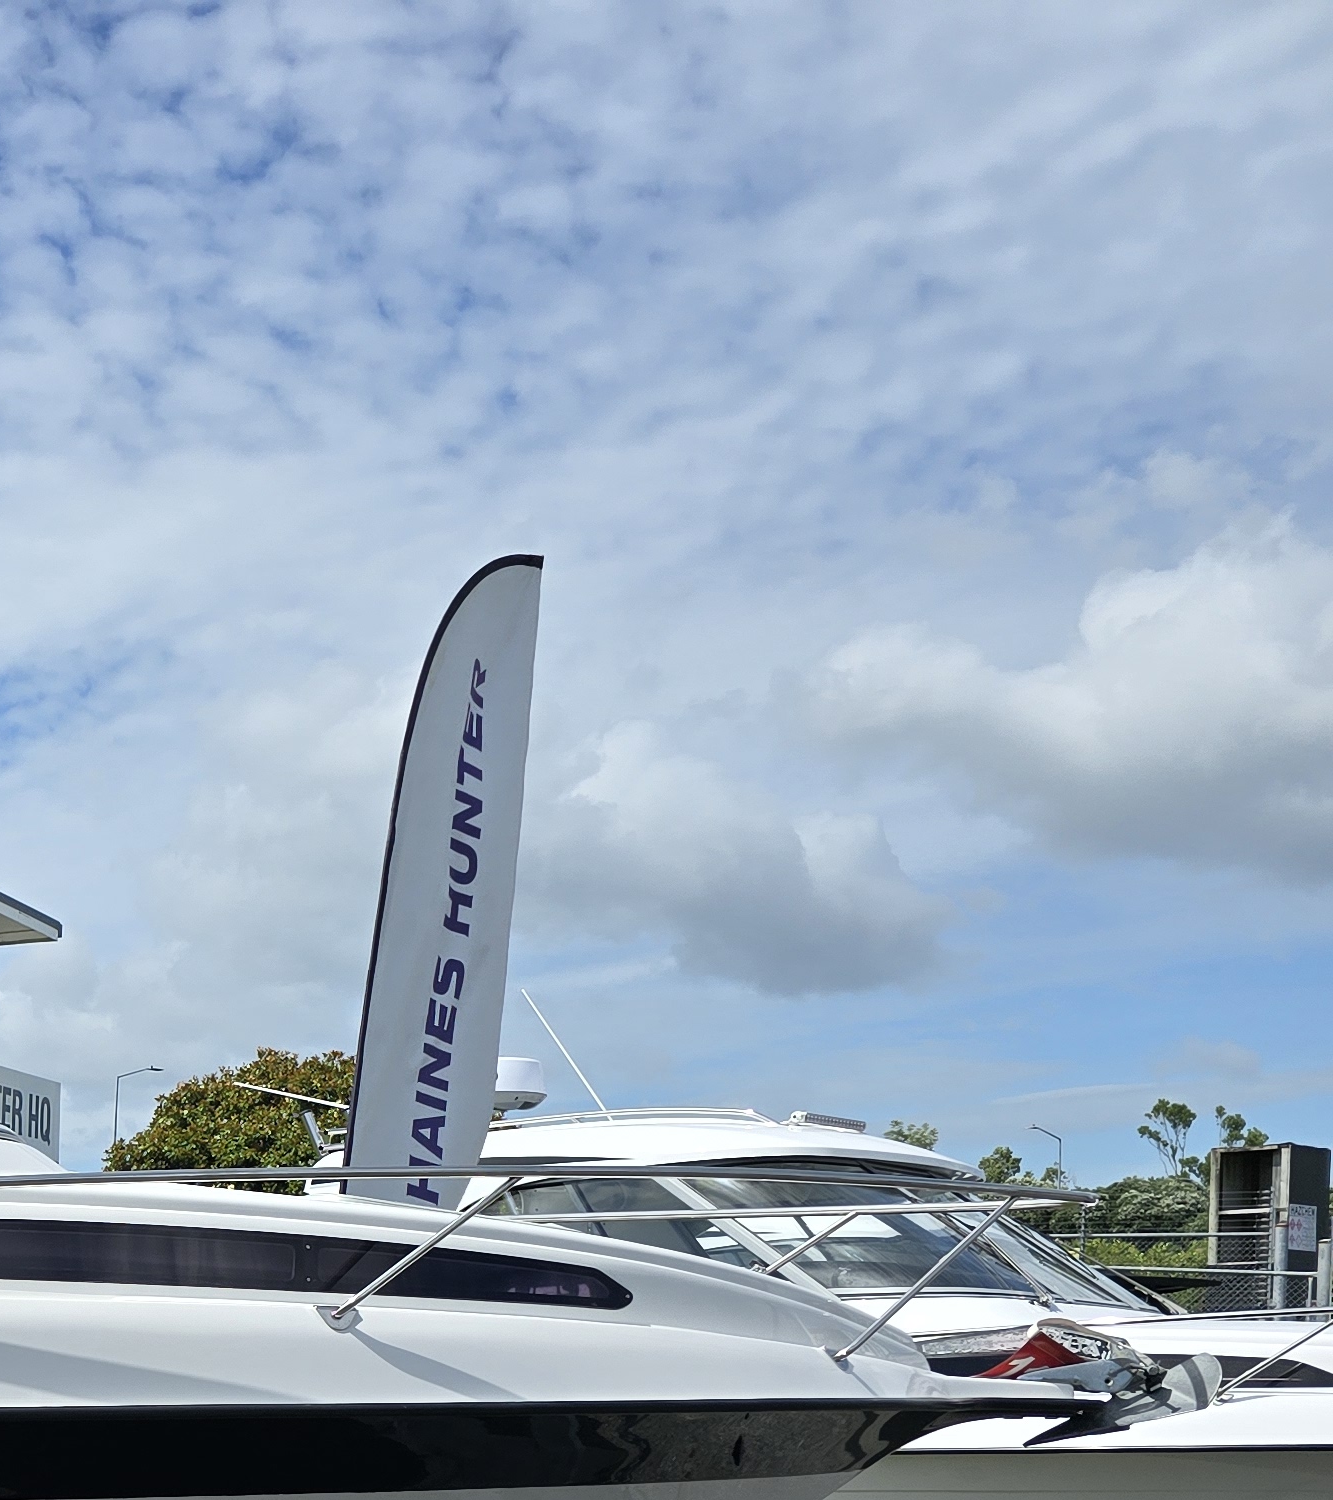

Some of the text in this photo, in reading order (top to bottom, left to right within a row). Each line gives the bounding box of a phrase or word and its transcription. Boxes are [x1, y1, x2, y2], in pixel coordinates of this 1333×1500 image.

[406, 657, 488, 1207] HAINES HUNTER
[28, 1093, 51, 1147] HQ
